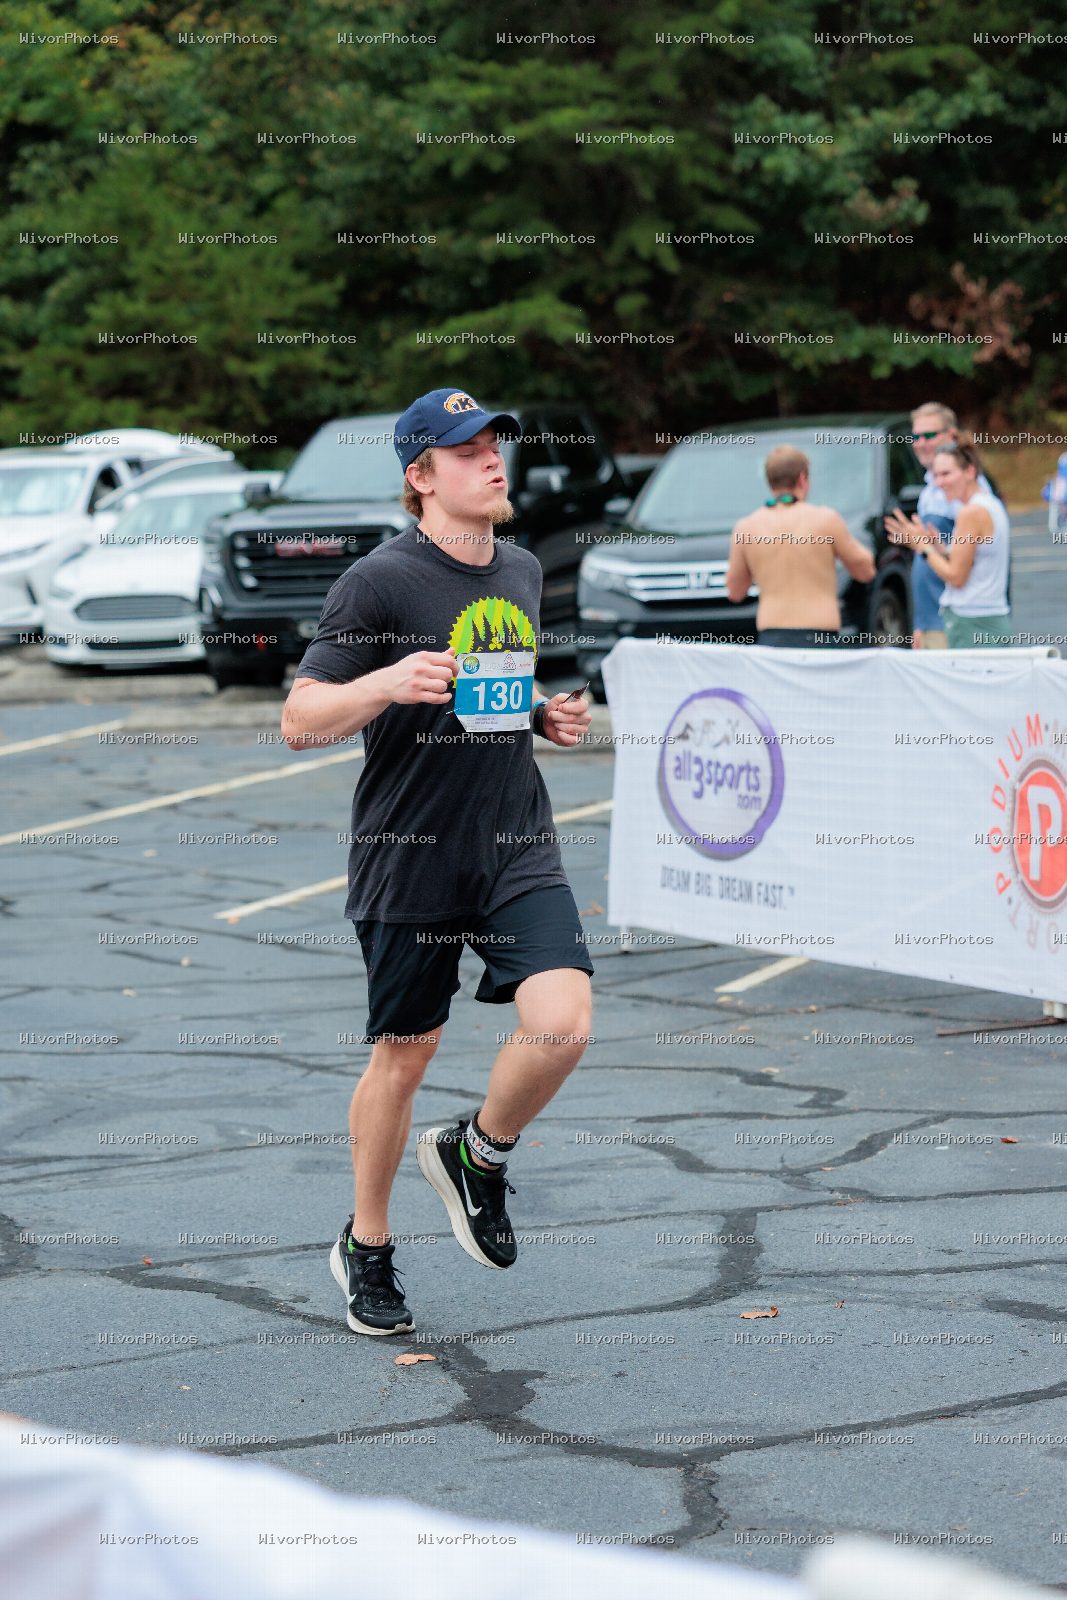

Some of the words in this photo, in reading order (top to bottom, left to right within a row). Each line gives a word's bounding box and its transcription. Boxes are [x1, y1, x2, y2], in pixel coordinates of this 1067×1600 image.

[472, 680, 523, 711] 130
[673, 750, 761, 799] all3sports
[987, 712, 1043, 896] PODIUM
[718, 874, 753, 905] DREAM
